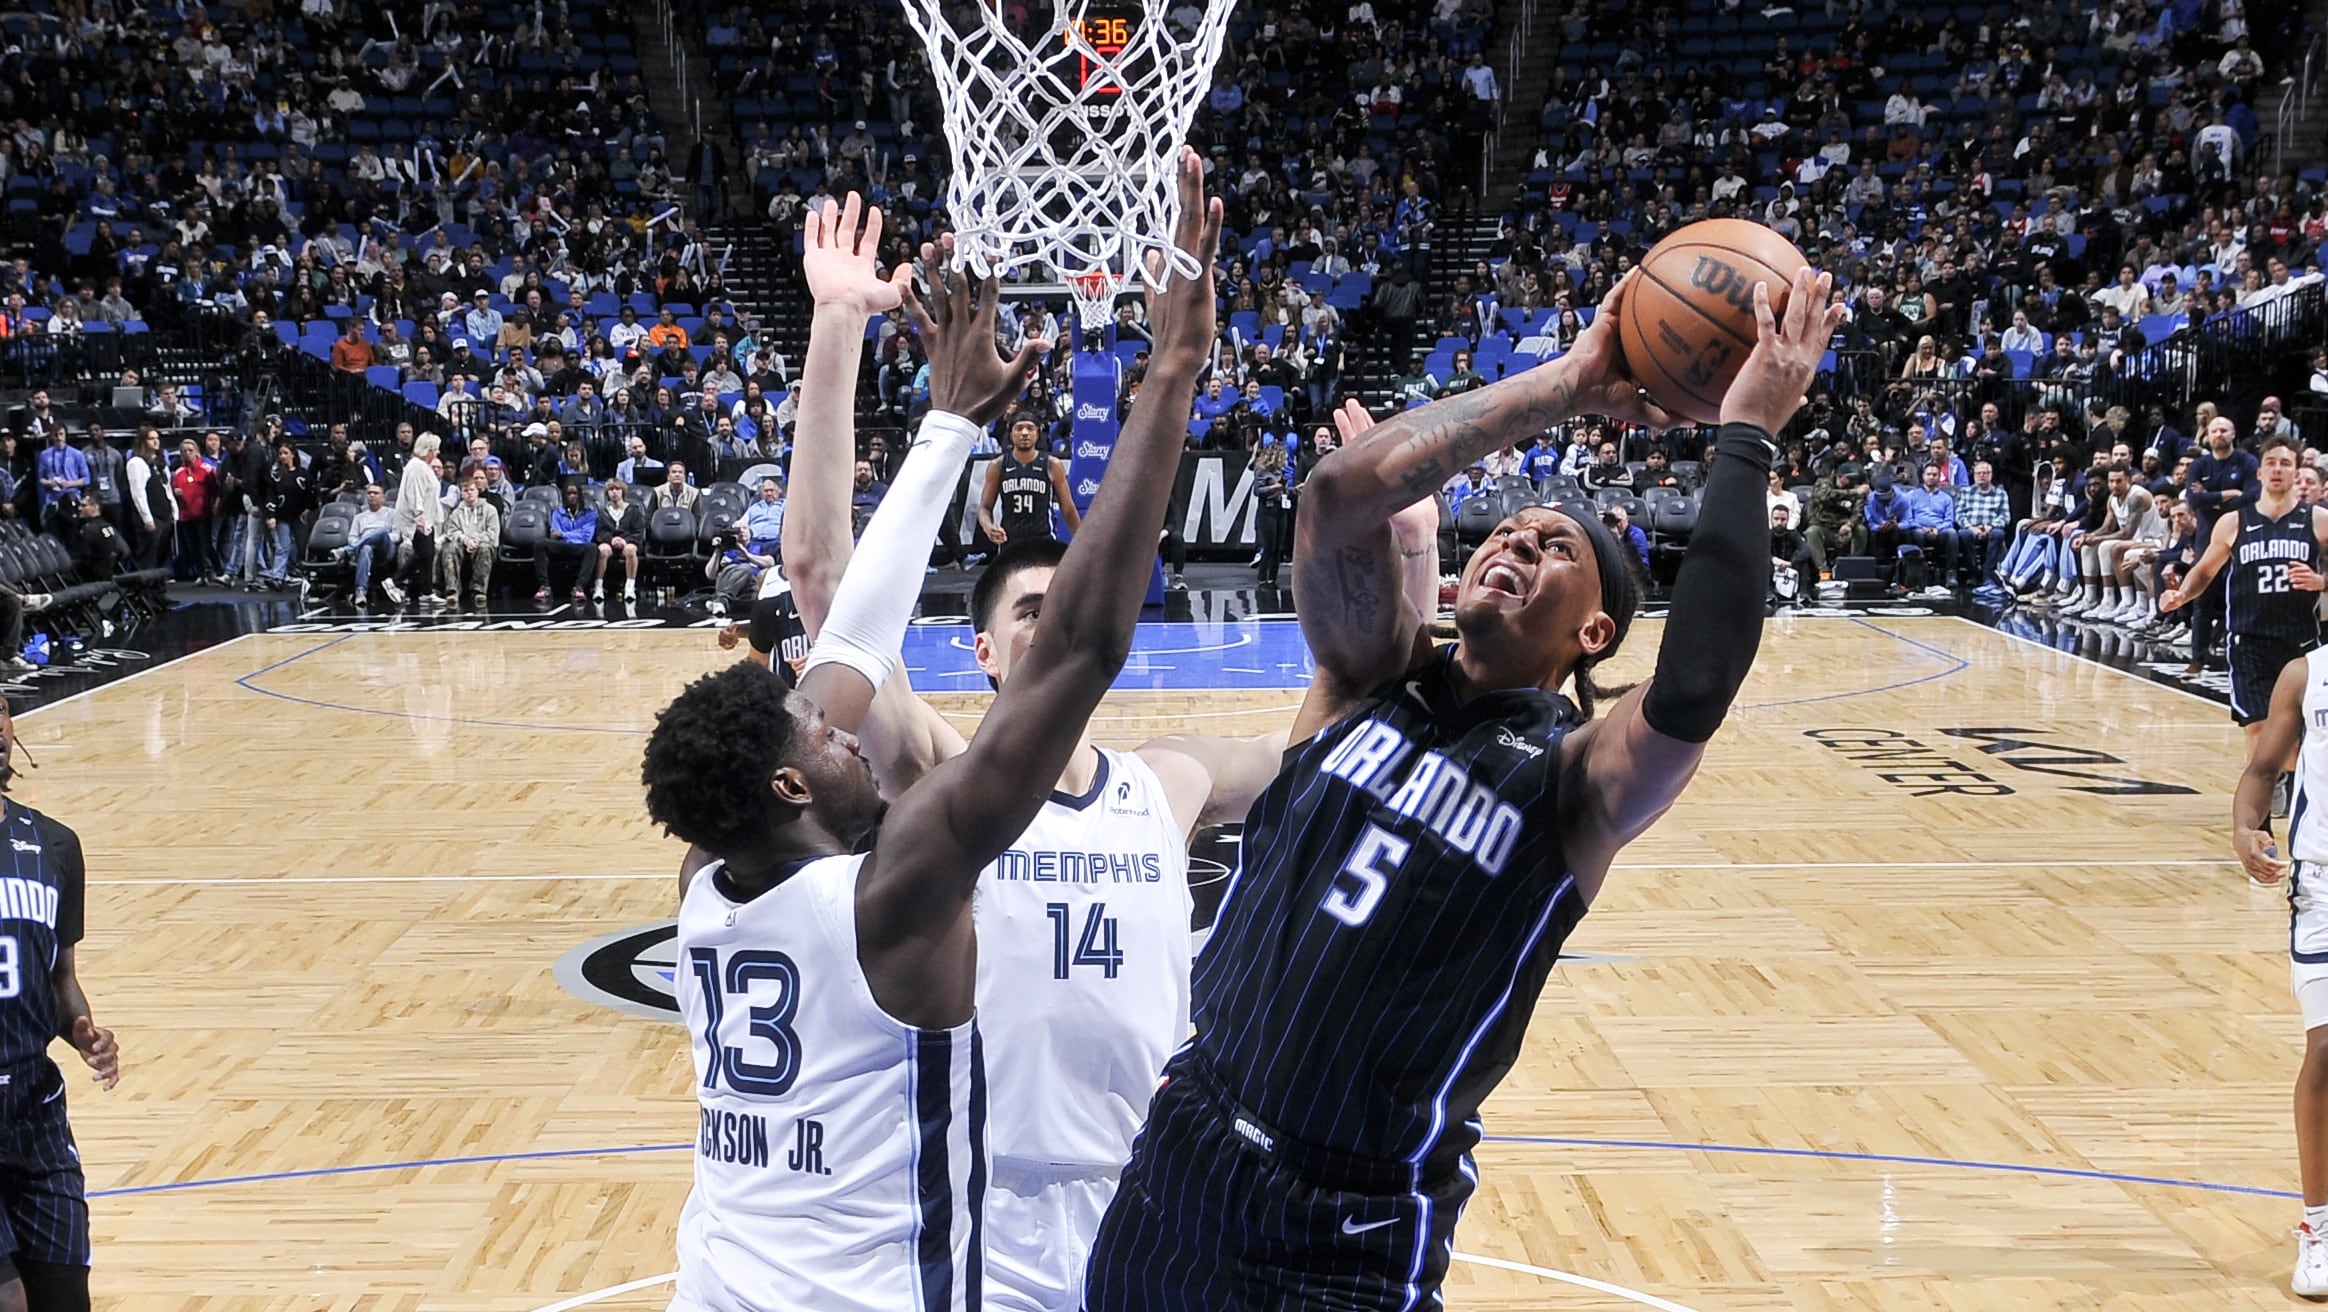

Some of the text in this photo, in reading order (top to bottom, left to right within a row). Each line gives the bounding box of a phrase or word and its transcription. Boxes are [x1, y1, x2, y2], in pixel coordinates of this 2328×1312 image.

[1078, 402, 1110, 422] Starry
[1078, 441, 1110, 460] Starry
[1002, 477, 1047, 494] ORLANDO
[1013, 494, 1033, 513] 34
[2240, 539, 2310, 565] ORLANDO
[2258, 564, 2290, 594] 22
[266, 618, 666, 633] ORLANDO
[1496, 725, 1545, 759] Disney
[1802, 728, 2017, 797] CENTER
[1320, 718, 1524, 878] ORLANDO
[997, 850, 1161, 884] MEMPHIS
[1321, 821, 1412, 928] 5
[1046, 902, 1124, 980] 14
[689, 947, 803, 1096] 13
[788, 1118, 832, 1176] JR.
[1234, 1118, 1274, 1152] MAGIC
